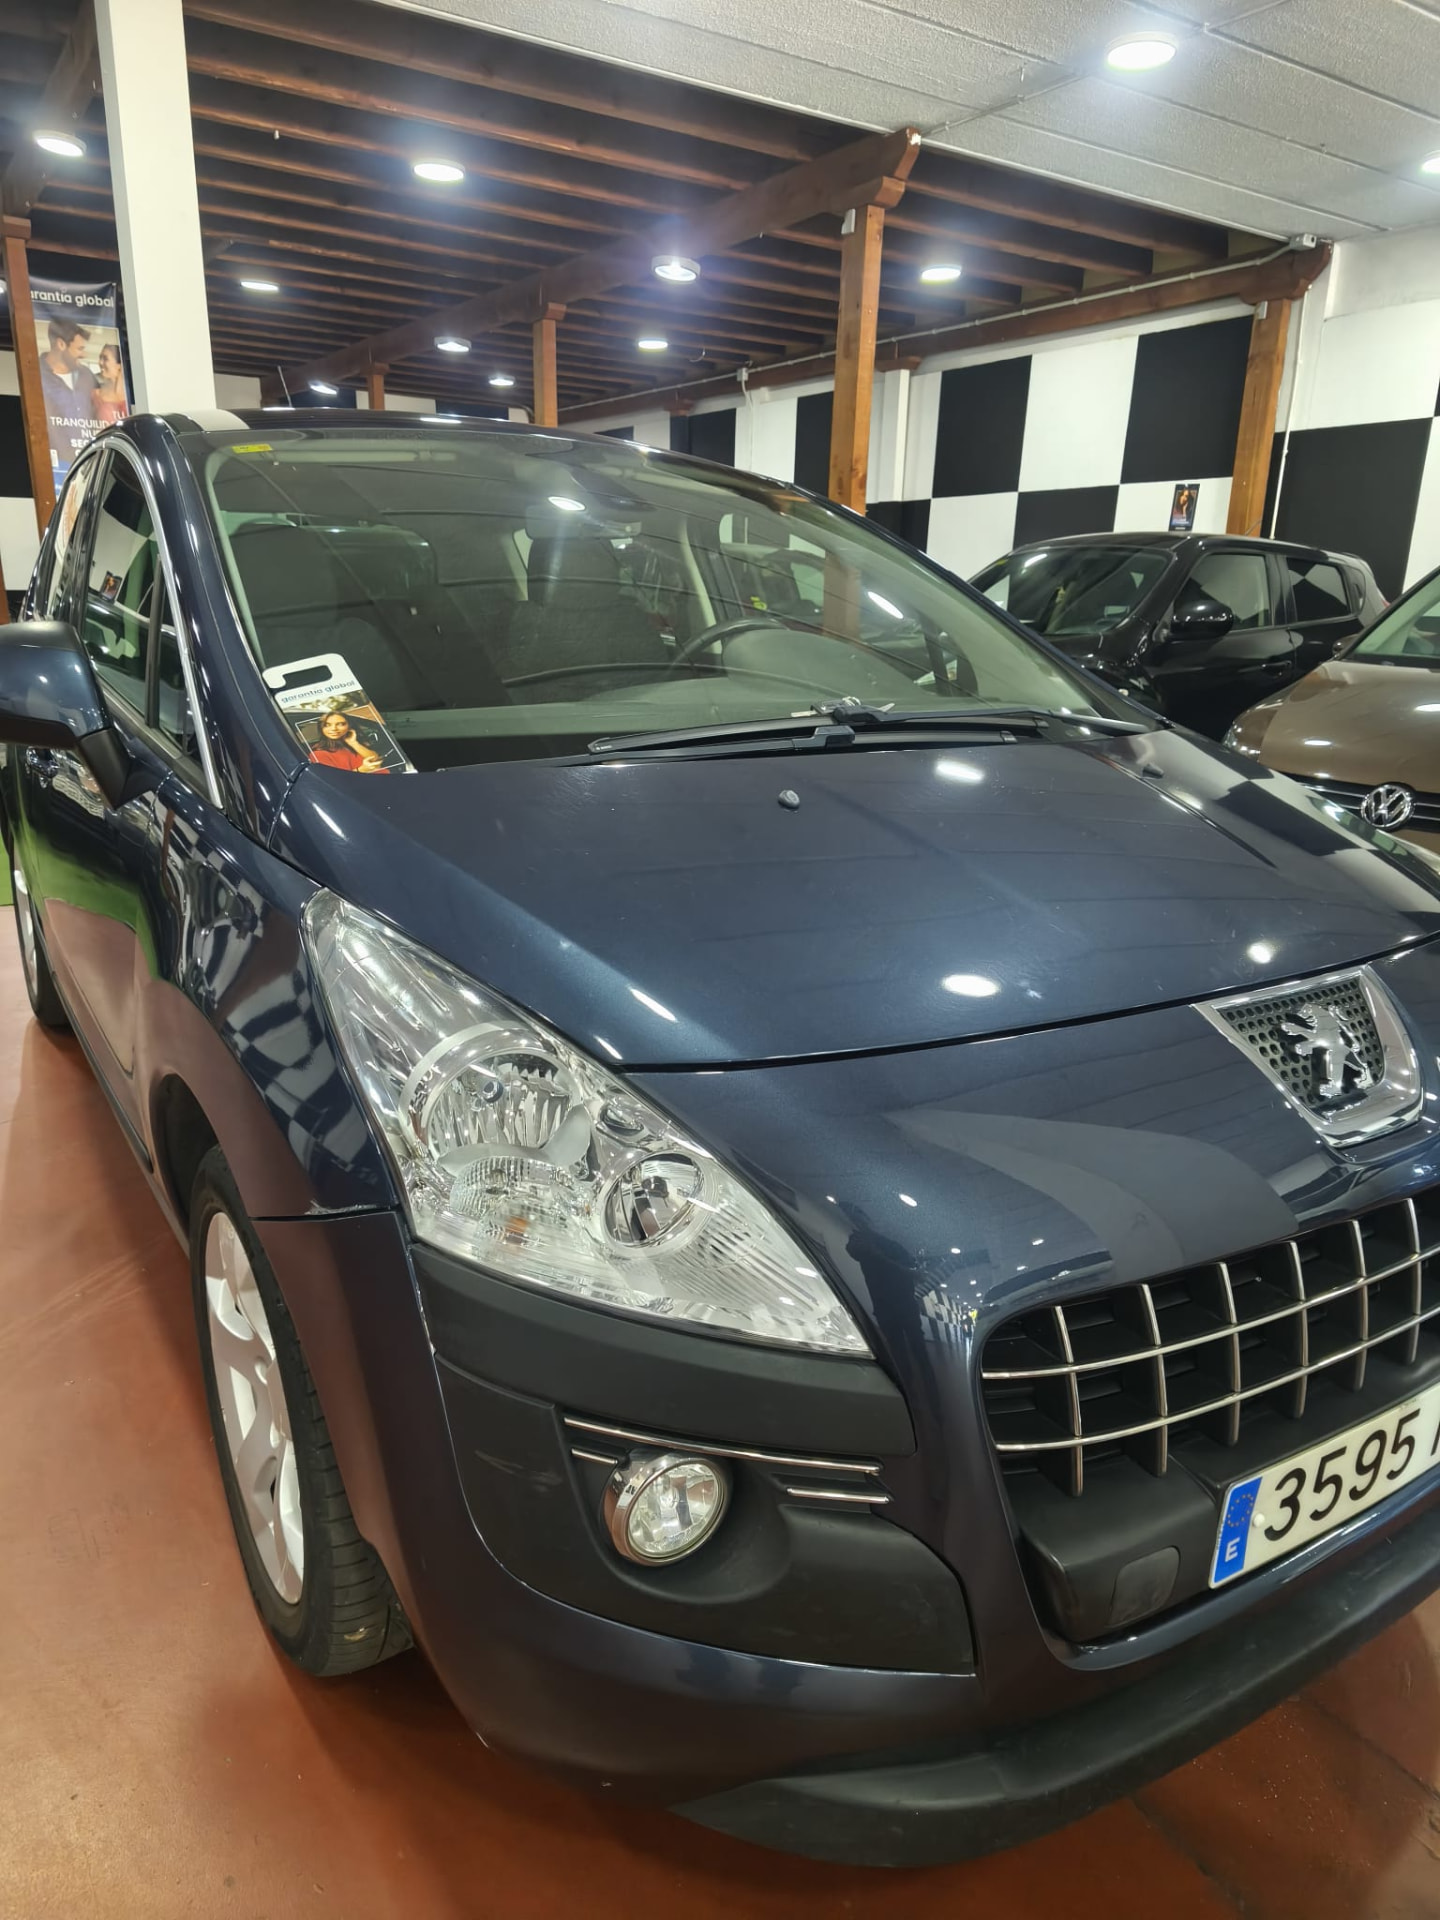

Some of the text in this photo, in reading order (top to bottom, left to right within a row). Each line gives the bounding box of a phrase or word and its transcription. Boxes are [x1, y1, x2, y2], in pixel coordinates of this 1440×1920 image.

[75, 293, 114, 308] global
[112, 410, 125, 420] TU
[50, 416, 114, 429] TRANQUILID
[324, 680, 355, 692] global
[1264, 1408, 1421, 1542] 3595
[1224, 1537, 1240, 1562] E
